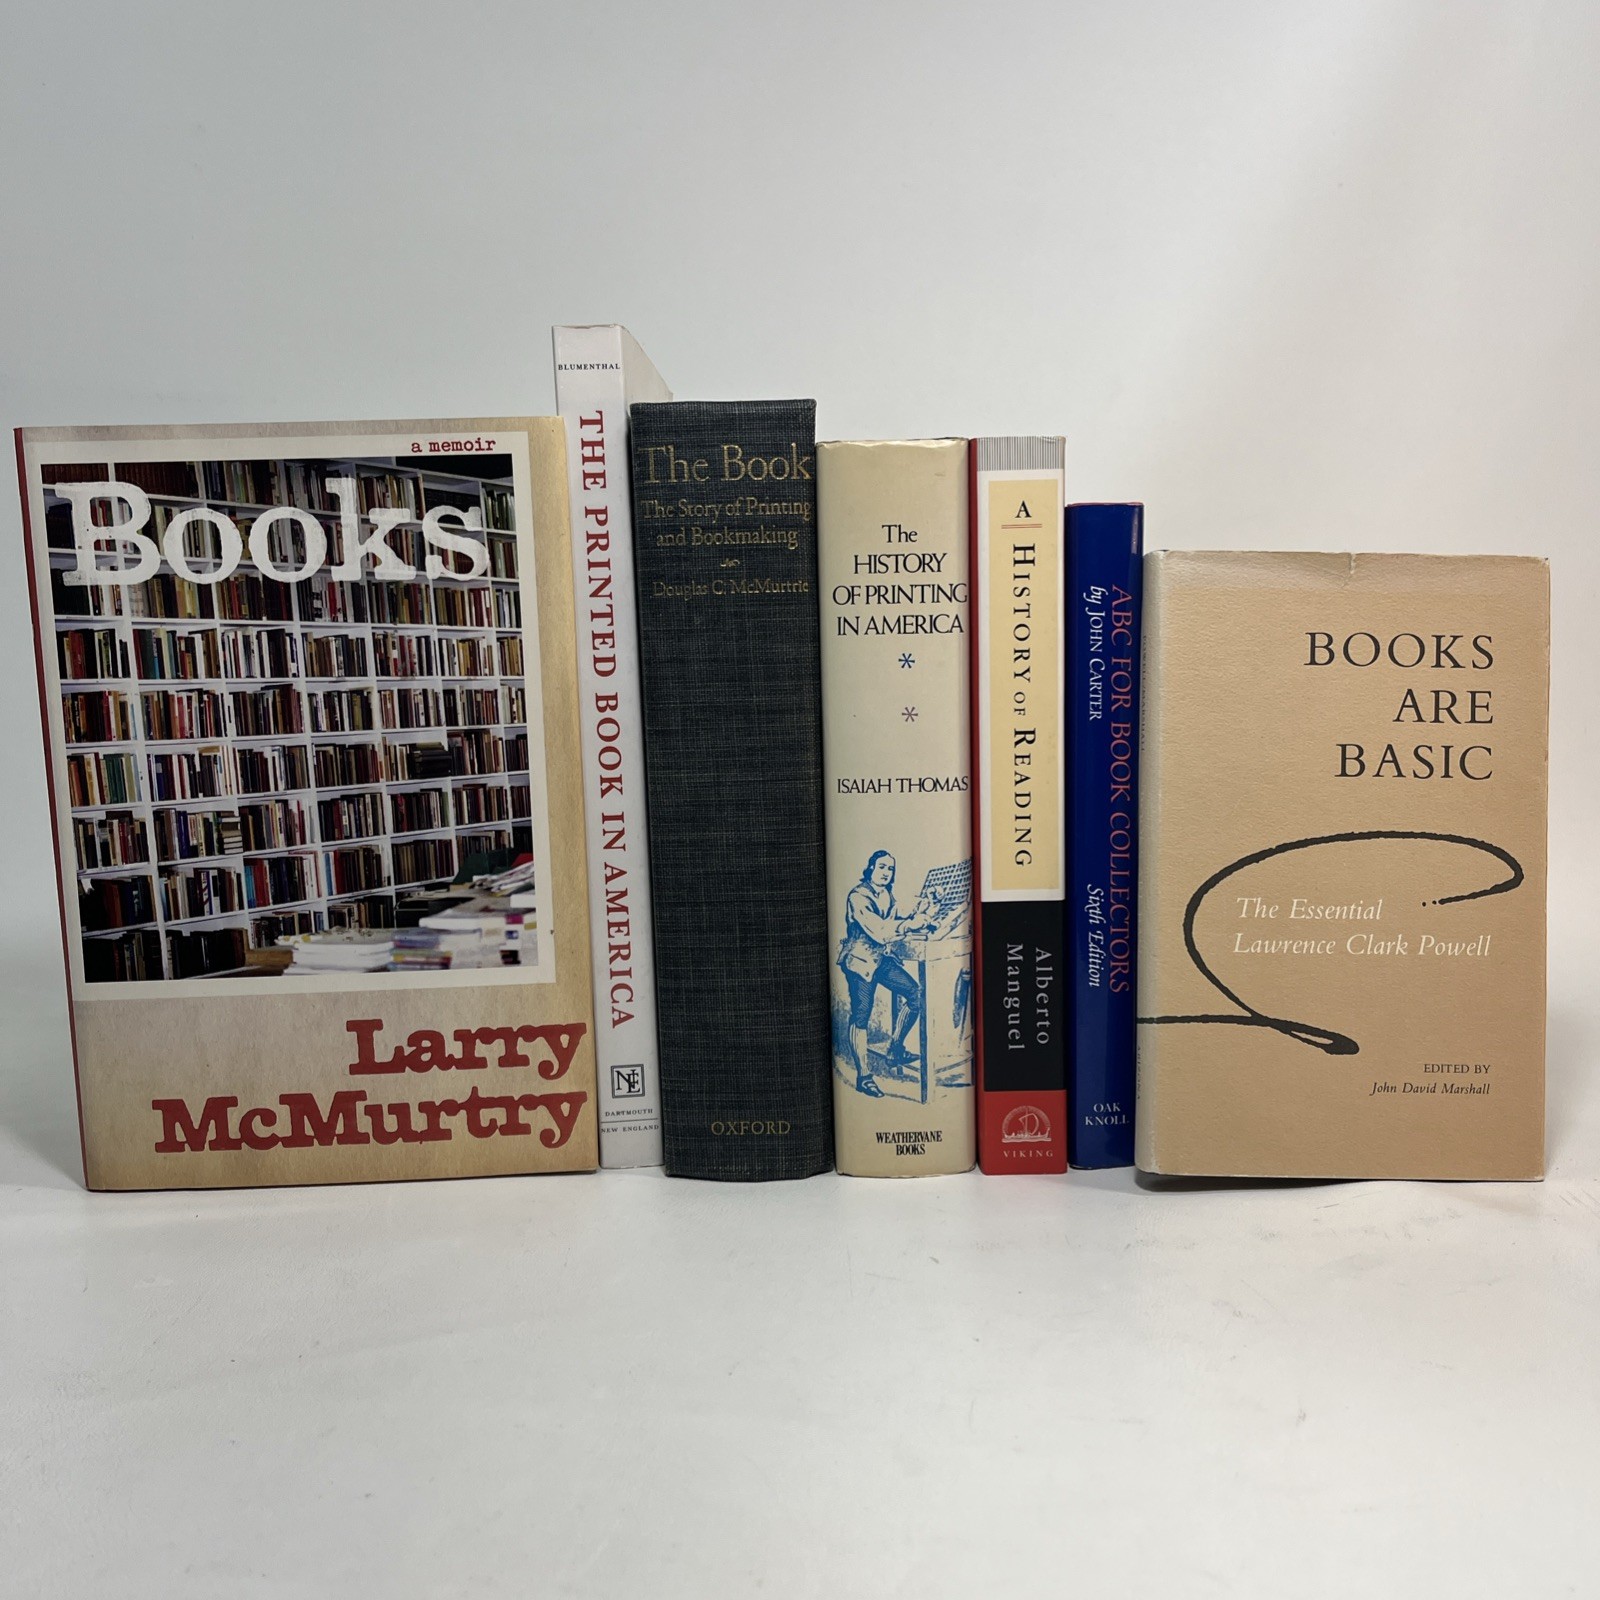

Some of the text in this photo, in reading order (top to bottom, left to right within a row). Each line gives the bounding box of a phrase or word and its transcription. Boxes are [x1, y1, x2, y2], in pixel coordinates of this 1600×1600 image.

[411, 436, 497, 453] a memoir
[638, 442, 812, 484] The Book
[642, 497, 811, 523] The Story of Printing
[1015, 500, 1032, 519] A
[55, 477, 490, 586] Books
[656, 525, 799, 549] and Bookmaking
[882, 524, 918, 543] The
[853, 552, 948, 575] HISTORY
[653, 581, 708, 600] Douglas
[730, 579, 809, 594] McMurtrie
[832, 582, 968, 606] OF PRINTING
[837, 613, 964, 636] IN AMERICA
[1083, 585, 1109, 721] by JOHN CARTER
[1303, 631, 1495, 670] BOOKS
[1012, 543, 1036, 867] HISTORY OF READING
[1392, 688, 1494, 725] ARE
[579, 410, 635, 1029] THE PRINTED BOOK IN AMERICA
[1334, 742, 1494, 781] BASIC
[837, 775, 969, 794] ISAIAH THOMAS
[1109, 584, 1133, 994] ABC FOR BOOK COLLECTORS
[1236, 897, 1383, 921] The Essential
[1084, 884, 1107, 988] Sixth Edition
[1233, 932, 1492, 957] Lawrence Clark Powell
[1002, 942, 1025, 1051] Manguel
[1035, 947, 1053, 1045] Alberto
[346, 1018, 587, 1080] Larry
[1423, 1063, 1491, 1074] EDITED BY
[1369, 1081, 1491, 1097] John David Marshall
[152, 1086, 588, 1153] McMurtry
[605, 1108, 653, 1117] DARTMOUTH
[1093, 1102, 1121, 1113] OAK
[622, 1124, 659, 1132] ENGLAND
[710, 1120, 791, 1136] OXFORD
[1084, 1114, 1130, 1126] KNOLL
[875, 1130, 943, 1144] WEATHERVANE
[896, 1144, 926, 1156] BOOKS
[1002, 1150, 1054, 1158] VIKING
